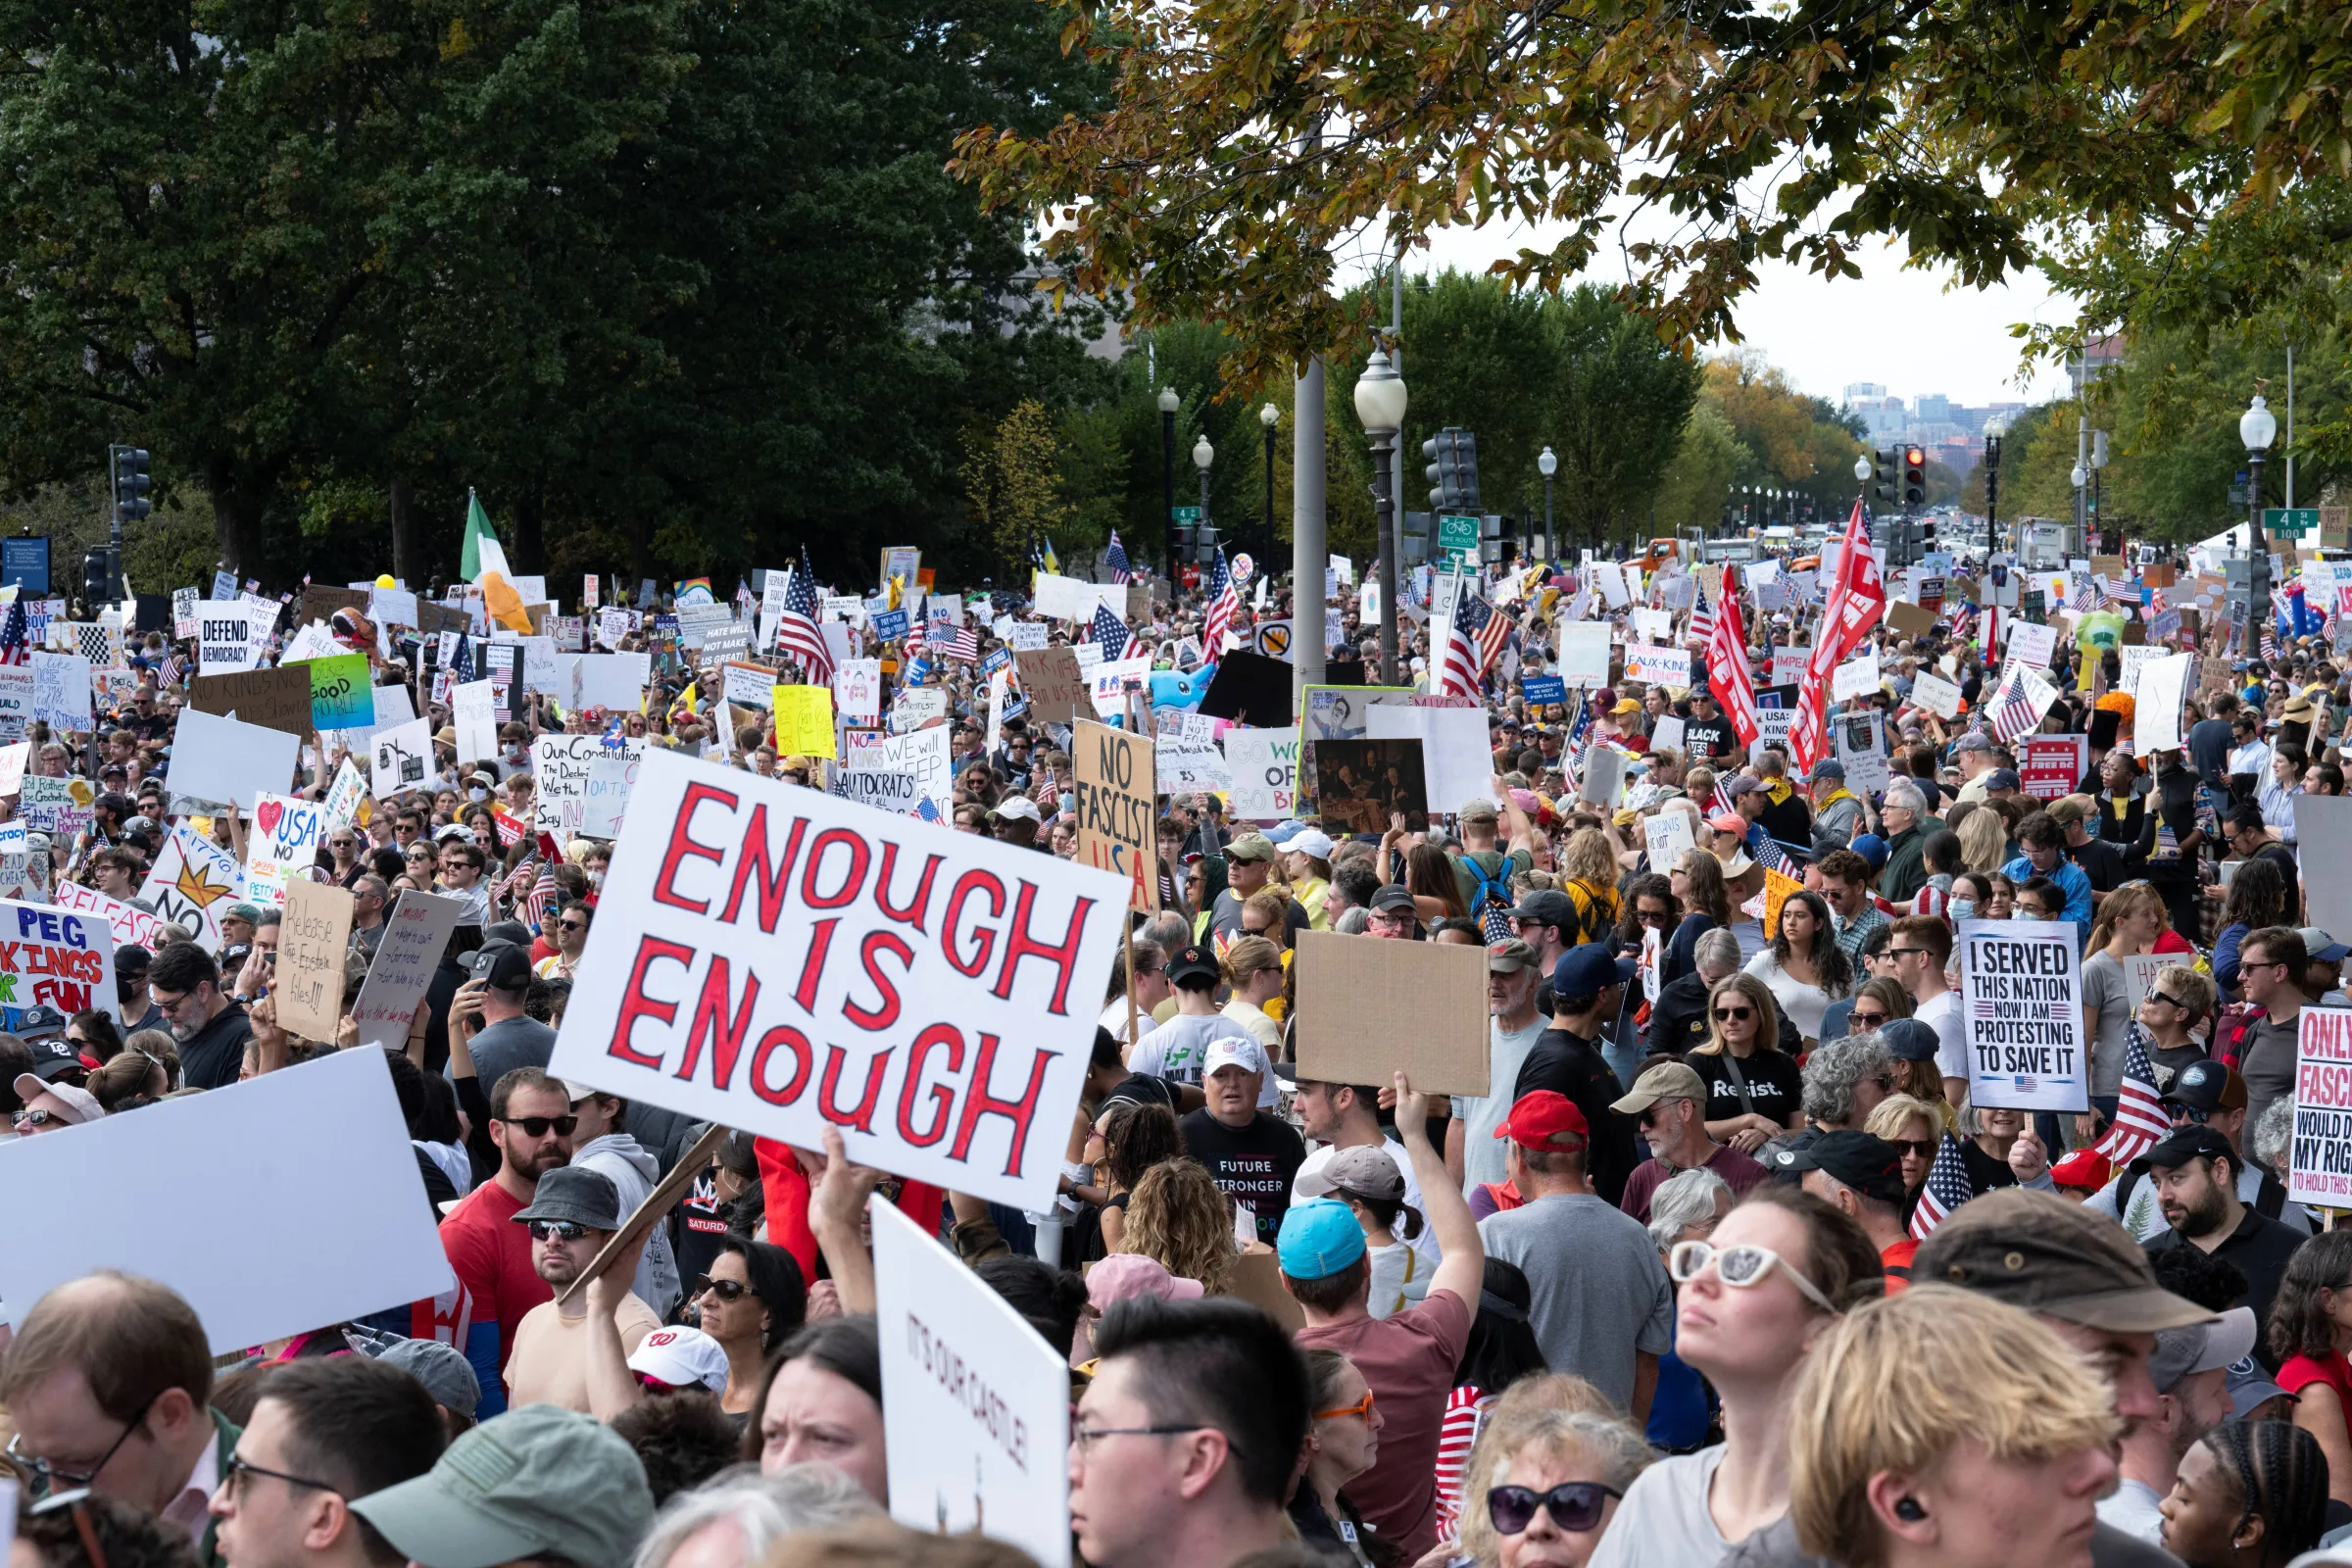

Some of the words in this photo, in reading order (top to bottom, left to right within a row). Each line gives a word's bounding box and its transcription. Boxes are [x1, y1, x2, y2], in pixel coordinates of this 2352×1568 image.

[1179, 509, 1186, 518] 4
[2279, 512, 2289, 526] 4
[2328, 514, 2340, 523] let
[2280, 529, 2300, 538] 100
[2325, 523, 2344, 534] this
[173, 588, 198, 604] WHERE
[305, 587, 343, 603] Swear
[349, 590, 364, 604] In
[27, 602, 48, 615] ISE
[177, 601, 194, 611] ARE
[177, 609, 195, 619] THE
[933, 608, 948, 617] NO
[175, 617, 200, 638] FILES
[545, 615, 571, 627] FREE
[203, 620, 248, 642] DEFEND
[545, 625, 564, 641] DC
[707, 627, 727, 638] HATE
[728, 622, 749, 636] WILL
[308, 633, 326, 653] RULE
[704, 641, 721, 652] NOT
[722, 637, 747, 650] MAKE
[2023, 642, 2049, 654] TYRANTS
[2029, 636, 2047, 646] KINGS
[203, 646, 248, 663] DEMOCRACY
[702, 655, 713, 665] US
[713, 651, 743, 663] GREAT!
[1629, 645, 1669, 657] TRUMP
[2019, 651, 2050, 662] FASCISTS
[2128, 649, 2142, 660] NO
[42, 655, 74, 671] like
[1628, 654, 1690, 672] FAUX-KING
[1776, 655, 1811, 668] IMPEA
[36, 668, 61, 685] ICE
[1646, 669, 1687, 683] IDIOT
[2203, 667, 2213, 676] NO
[190, 676, 214, 703] NO
[222, 671, 271, 699] KINGS
[277, 668, 304, 691] NO
[311, 678, 351, 699] GOOD
[1525, 682, 1561, 691] DEMOCRACY
[1919, 677, 1936, 693] Love
[1937, 689, 1954, 700] your
[266, 697, 292, 720] Show
[906, 702, 937, 711] PROTEST
[1766, 711, 1789, 721] USA:
[1187, 724, 1209, 735] NOT
[1687, 728, 1721, 743] BLACK
[1764, 724, 1788, 735] KING
[849, 732, 868, 748] NO
[1184, 734, 1208, 744] FOR
[542, 742, 568, 760] Our
[885, 735, 915, 763] WE
[918, 735, 940, 754] will
[1178, 744, 1201, 756] Based
[1231, 740, 1266, 764] GO
[850, 751, 884, 769] KINGS
[1100, 734, 1132, 791] NO
[543, 764, 558, 775] The
[38, 778, 67, 791] Rather
[541, 775, 562, 794] We
[562, 782, 579, 797] the
[590, 780, 627, 798] OATH
[841, 772, 914, 799] AUTOCRATS
[2027, 788, 2052, 797] FREE
[2053, 788, 2070, 797] DC
[24, 792, 35, 802] be
[325, 772, 349, 819] ABOLISH
[874, 797, 887, 808] ALL
[1232, 787, 1266, 811] GO
[59, 807, 95, 821] Women's
[337, 796, 349, 816] ICE
[537, 804, 561, 828] Say
[1077, 780, 1152, 851] FASCIST
[277, 806, 318, 847] USA
[1656, 834, 1669, 850] NOT
[190, 835, 232, 874] 1776
[273, 844, 293, 861] NO
[249, 881, 274, 899] PETTY
[1768, 872, 1789, 892] STOP
[653, 781, 1099, 1016] ENOUGH
[56, 881, 164, 955] RELEASE
[154, 888, 204, 941] NO
[286, 897, 333, 944] Release
[17, 906, 87, 950] PEG
[0, 940, 103, 984] KINGS
[284, 935, 297, 964] the
[298, 943, 330, 974] Epstein
[1970, 941, 1978, 972] I
[1984, 942, 2069, 976] SERVED
[790, 917, 916, 1031] IS
[33, 978, 92, 1014] FUN
[1972, 975, 2008, 1000] THIS
[2013, 977, 2071, 1002] NATION
[1993, 1001, 2022, 1018] NOW
[2024, 1003, 2028, 1019] I
[2032, 1003, 2050, 1019] AM
[1974, 1020, 2074, 1046] PROTESTING
[608, 934, 1063, 1179] ENOUGH
[1976, 1045, 2001, 1072] TO
[2005, 1046, 2052, 1074] SAVE
[2057, 1048, 2075, 1075] IT
[1164, 1067, 1187, 1083] MAY
[2297, 1110, 2341, 1140] WOULD
[2293, 1137, 2321, 1172] MY
[1219, 1160, 1272, 1173] FUTURE
[1213, 1179, 1283, 1192] STRONGER
[2293, 1172, 2304, 1191] TO
[2306, 1174, 2328, 1194] HOLD
[2329, 1176, 2349, 1197] THIS
[1242, 1200, 1256, 1211] IN
[688, 1218, 728, 1232] SATURDA
